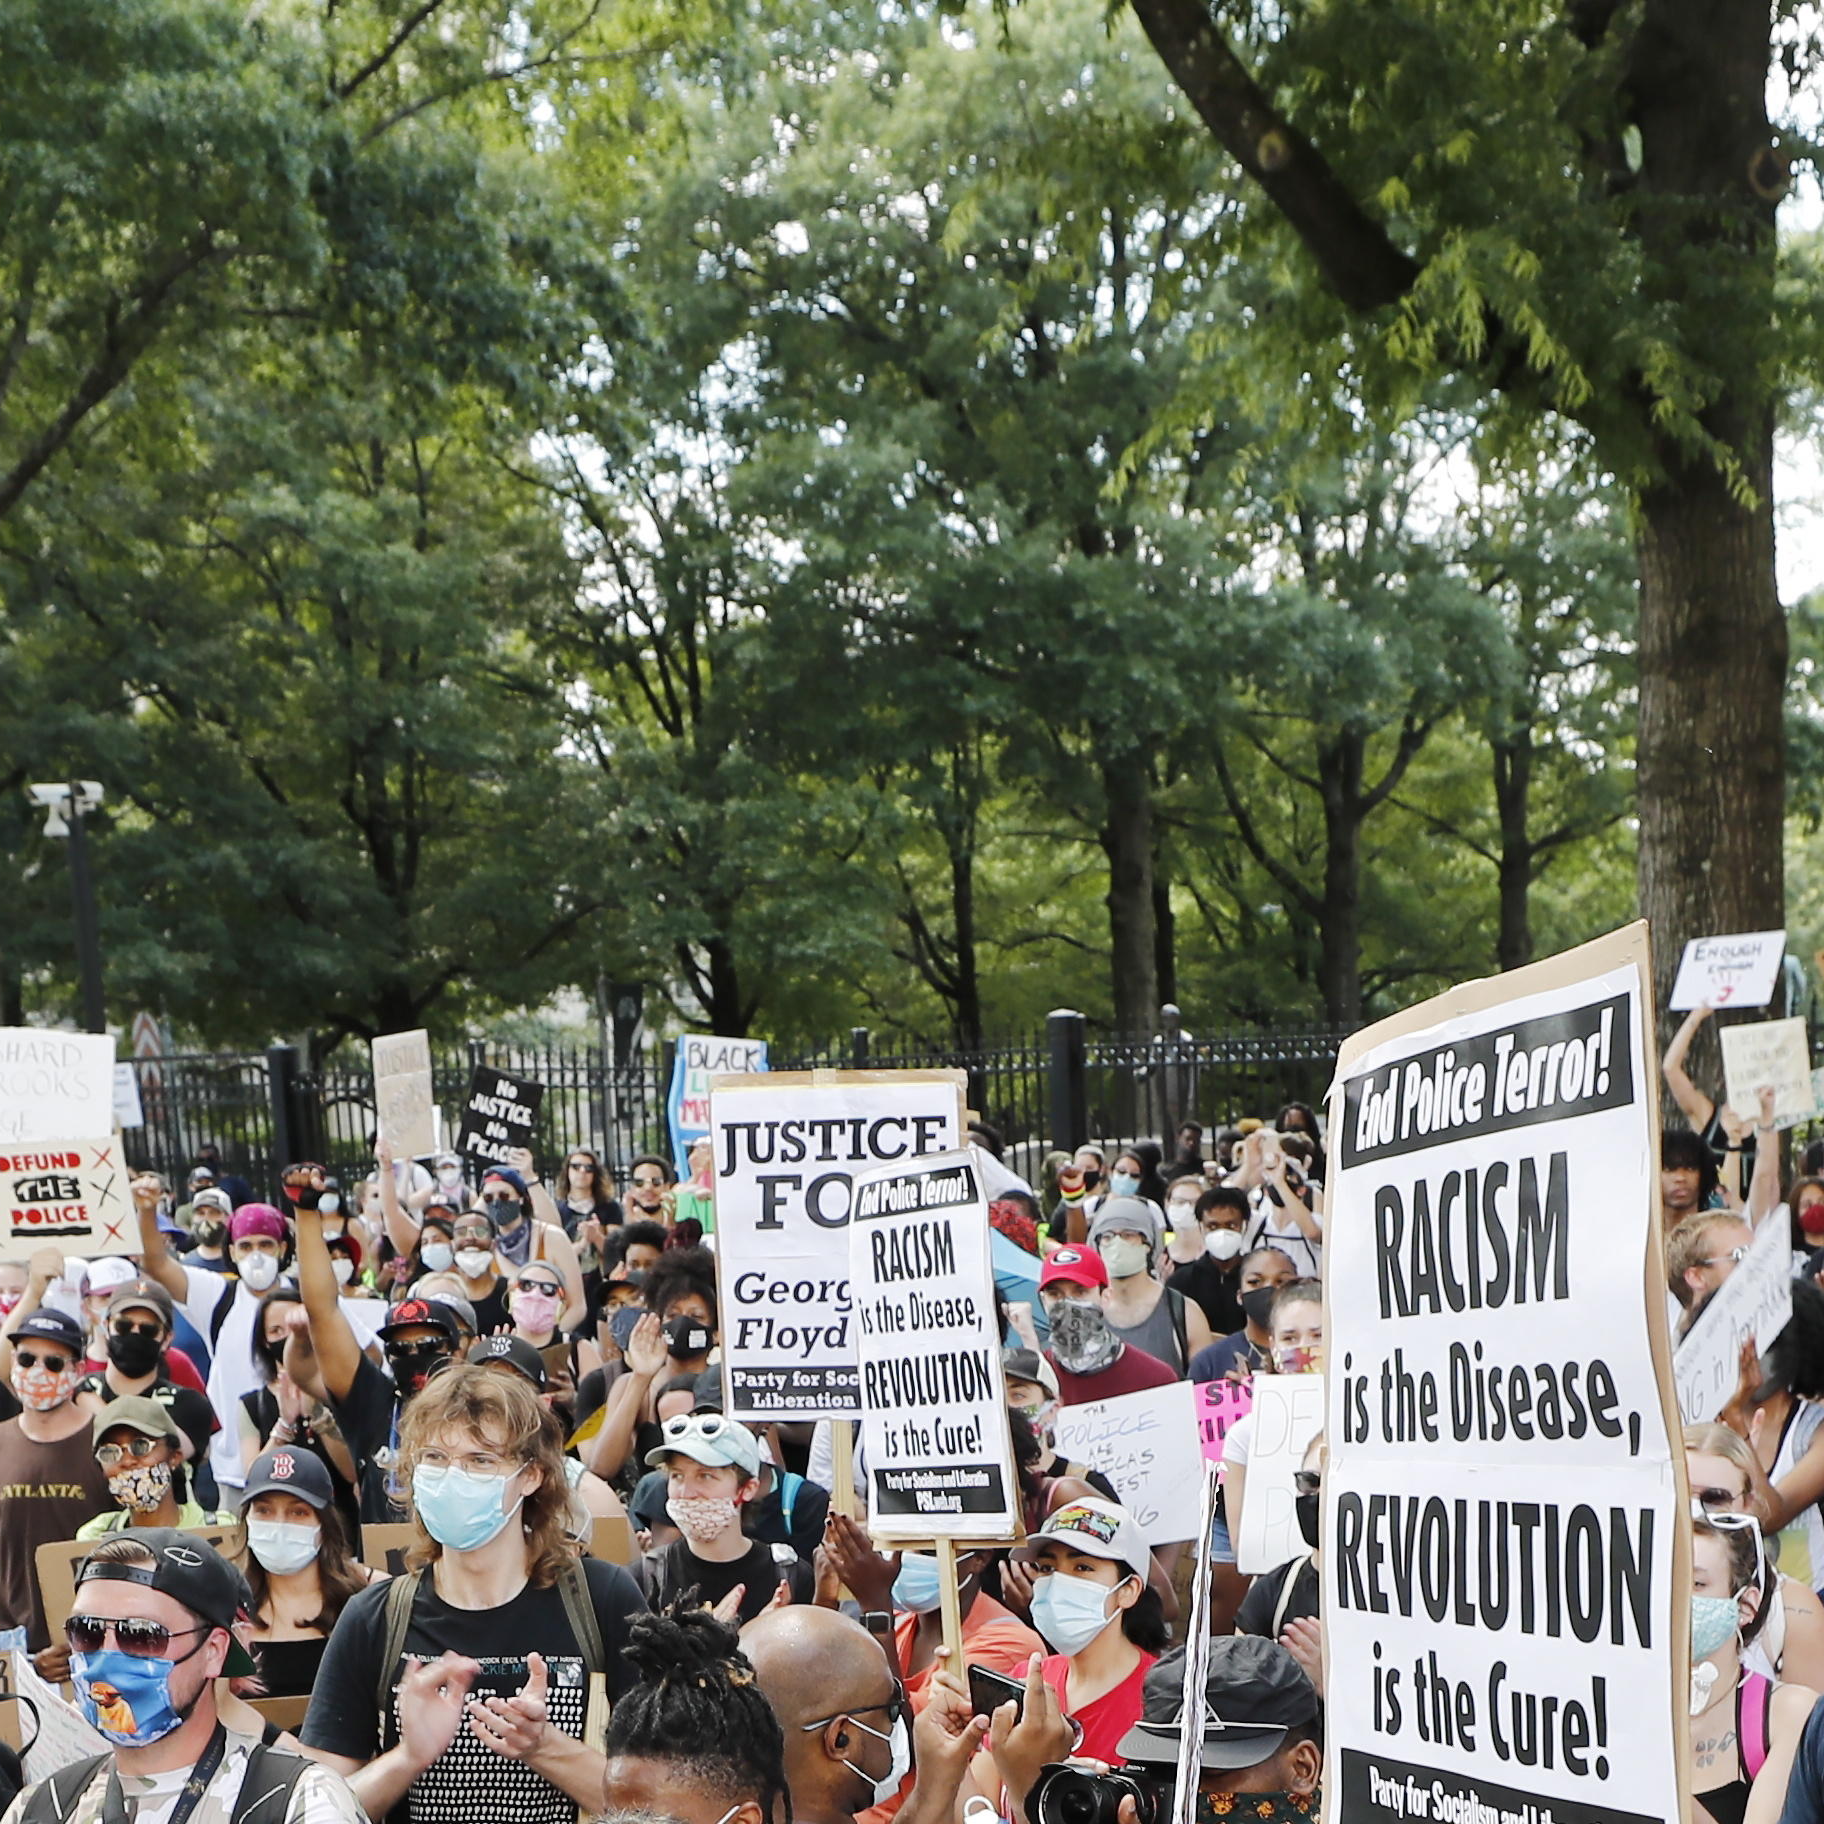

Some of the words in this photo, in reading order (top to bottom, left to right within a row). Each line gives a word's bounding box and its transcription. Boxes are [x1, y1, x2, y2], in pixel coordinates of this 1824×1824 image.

[687, 1038, 760, 1074] BLACK
[1355, 1076, 1398, 1153] End
[1400, 1048, 1485, 1142] Police
[1492, 1006, 1615, 1119] Terror!
[470, 1092, 533, 1127] JUSTICE
[720, 1115, 947, 1178] JUSTICE
[17, 1179, 76, 1200] THE
[756, 1172, 852, 1231] FO
[860, 1182, 880, 1216] End
[881, 1177, 918, 1212] Police
[920, 1168, 969, 1207] Terror!
[10, 1205, 89, 1225] POLICE
[1374, 1150, 1569, 1320] RACISM
[871, 1219, 956, 1283] RACISM
[734, 1272, 852, 1312] Georg
[858, 1297, 873, 1335] is
[876, 1295, 904, 1333] the
[909, 1291, 982, 1333] Disease,
[734, 1316, 849, 1359] Floyd
[733, 1369, 787, 1391] Party
[792, 1369, 820, 1388] for
[752, 1391, 856, 1410] Liberation
[864, 1349, 993, 1409] REVOLUTION
[1343, 1352, 1369, 1444] is
[1380, 1348, 1438, 1443] the
[1449, 1341, 1642, 1456] Disease,
[1060, 1409, 1162, 1449] POLICE
[1083, 1404, 1107, 1418] THE
[884, 1421, 898, 1458] is
[903, 1419, 930, 1457] the
[934, 1414, 982, 1457] Cure!
[1336, 1491, 1655, 1650] REVOLUTION
[1373, 1640, 1402, 1736] is
[1414, 1650, 1477, 1753] the
[1488, 1660, 1611, 1782] Cure!
[1369, 1764, 1405, 1820] Party
[1405, 1778, 1431, 1818] for
